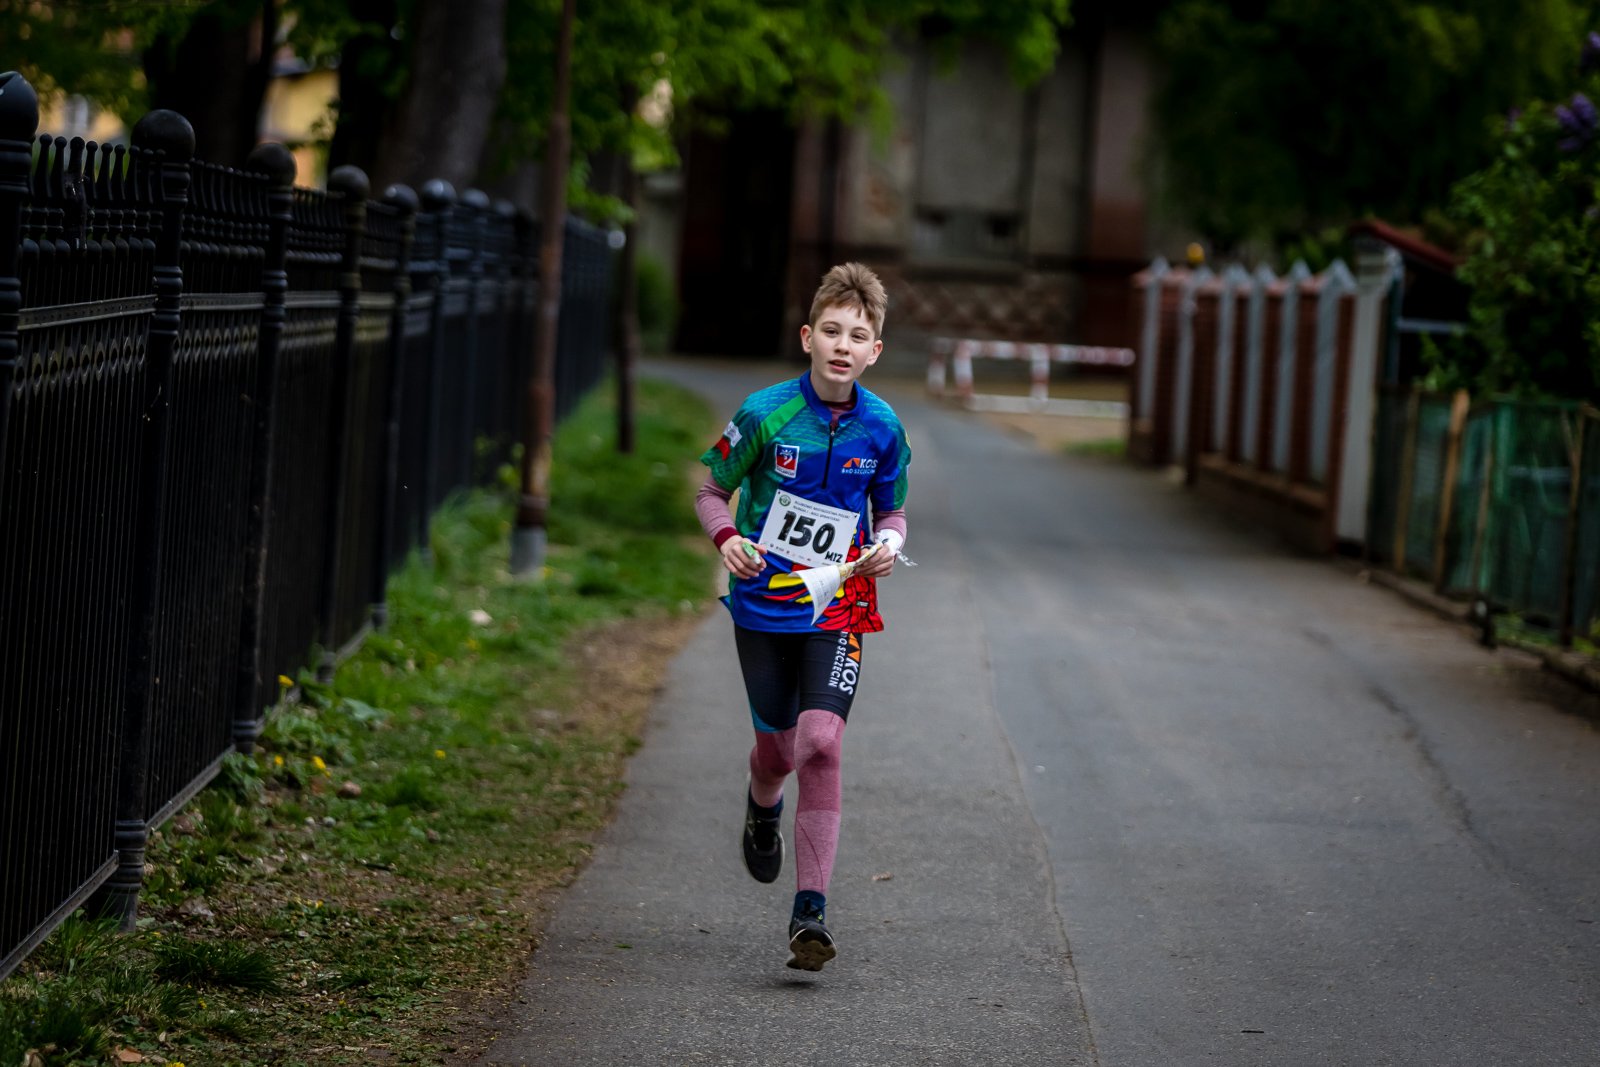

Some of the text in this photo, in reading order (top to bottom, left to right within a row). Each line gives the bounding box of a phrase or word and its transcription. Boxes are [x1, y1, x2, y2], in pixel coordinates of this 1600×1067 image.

[859, 458, 878, 469] KOS
[777, 510, 836, 555] 150
[828, 646, 847, 688] SZCZECIN
[839, 657, 859, 695] KOS
